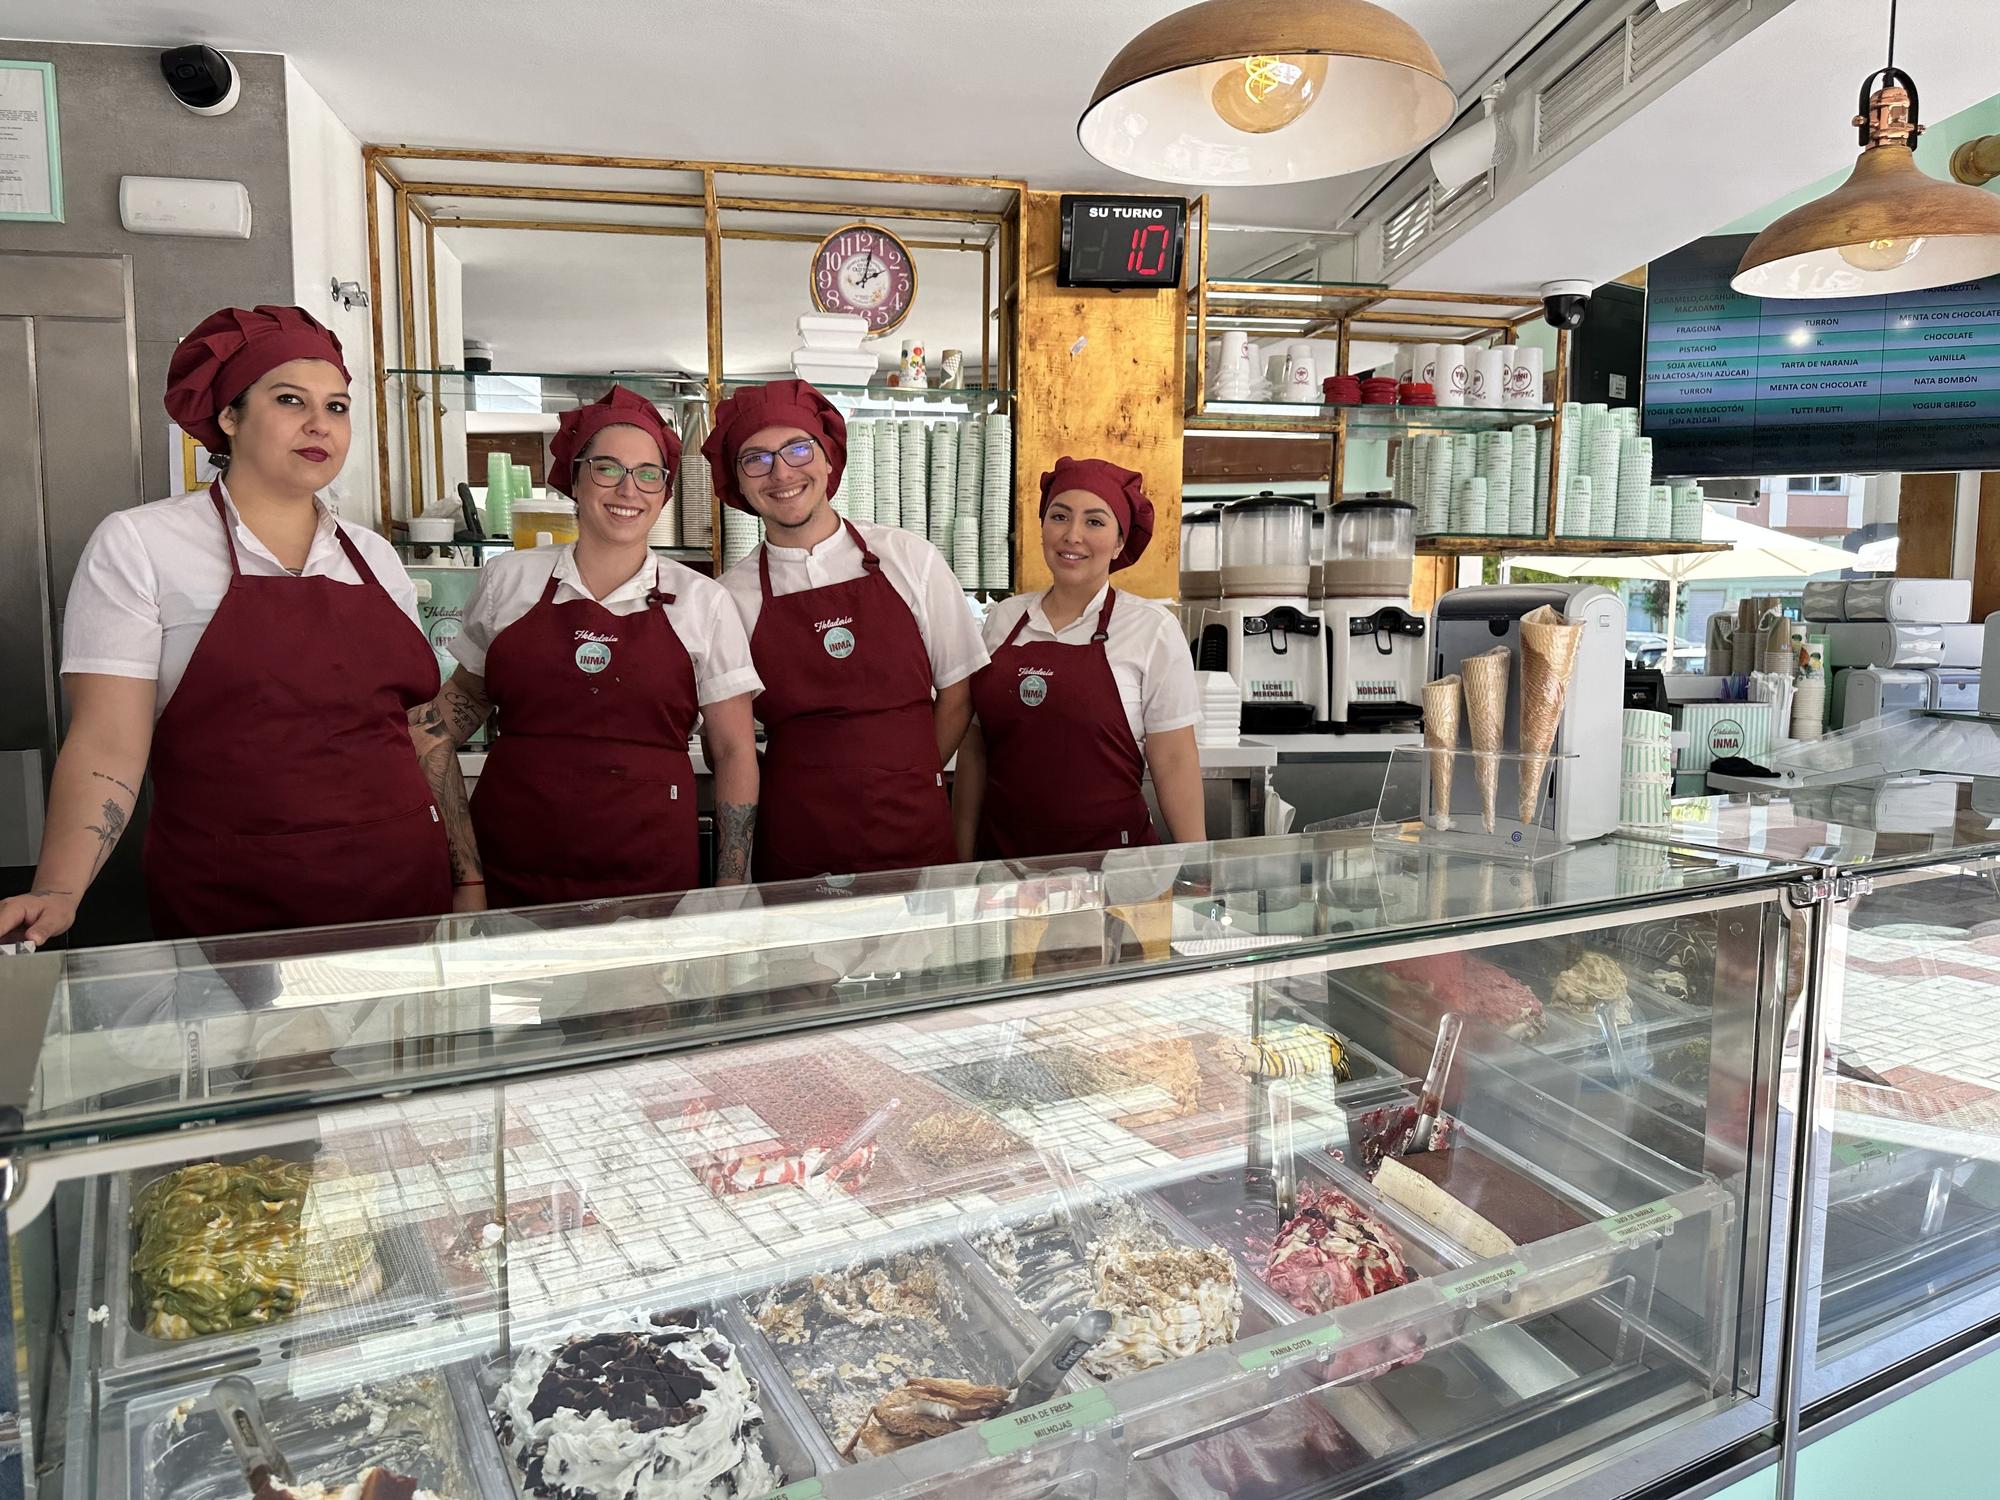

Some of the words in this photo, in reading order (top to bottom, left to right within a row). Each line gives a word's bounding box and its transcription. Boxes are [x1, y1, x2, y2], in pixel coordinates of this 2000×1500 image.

[1089, 207, 1109, 218] SU
[1112, 208, 1163, 219] TURNO
[840, 236, 852, 256] 11
[855, 233, 873, 252] 12
[879, 237, 884, 257] 1
[1127, 224, 1169, 276] 10
[825, 251, 842, 272] 10
[888, 251, 901, 270] 2
[819, 270, 832, 289] 9
[898, 272, 910, 292] 3
[826, 289, 840, 308] 8
[889, 291, 903, 311] 4
[1674, 304, 1725, 314] MACADAMIA
[1899, 313, 1929, 321] MENTA
[1931, 312, 1950, 320] CON
[1951, 309, 2000, 318] CHOCOLATE
[860, 310, 872, 327] 6
[877, 306, 889, 325] 5
[1676, 325, 1721, 334] FRAGOLINA
[1923, 332, 1974, 341] CHOCOLATE
[1679, 345, 1717, 353] PISTACHO
[1808, 360, 1819, 368] DE
[1820, 359, 1859, 368] NARANJA
[1928, 353, 1966, 362] VAINILLA
[1667, 362, 1686, 370] SOJA
[1687, 360, 1728, 369] AVELLANA
[1662, 371, 1713, 380] LACTOSA/SIN
[1714, 369, 1750, 378] AZÚCAR)
[1937, 375, 1978, 384] BOMBÓN
[1769, 384, 1799, 392] MENTA
[1800, 383, 1818, 391] CON
[1820, 380, 1868, 389] CHOCOLATE
[1815, 405, 1843, 414] FRUTTI
[1912, 402, 1942, 410] YOGUR
[1943, 400, 1977, 409] GRIEGO
[1647, 408, 1674, 417] YOGUR
[1675, 407, 1693, 416] CON
[828, 640, 852, 652] INMA
[580, 655, 606, 665] INMA
[1262, 683, 1283, 691] LECHE
[1357, 686, 1397, 696] HORCHATA
[1023, 689, 1043, 699] INMA
[1252, 690, 1294, 698] MERENGADA
[1712, 738, 1739, 749] INMA
[1455, 1281, 1480, 1294] DELICIAS
[1478, 1275, 1499, 1286] FRUTOS
[1498, 1268, 1516, 1279] ROJOS
[1270, 1345, 1292, 1357] PANNA
[1292, 1339, 1312, 1350] COTTA
[1014, 1414, 1039, 1426] TARTA
[1039, 1410, 1049, 1419] DE
[1050, 1401, 1074, 1415] FRESA
[1034, 1420, 1073, 1438] MILHOJAS
